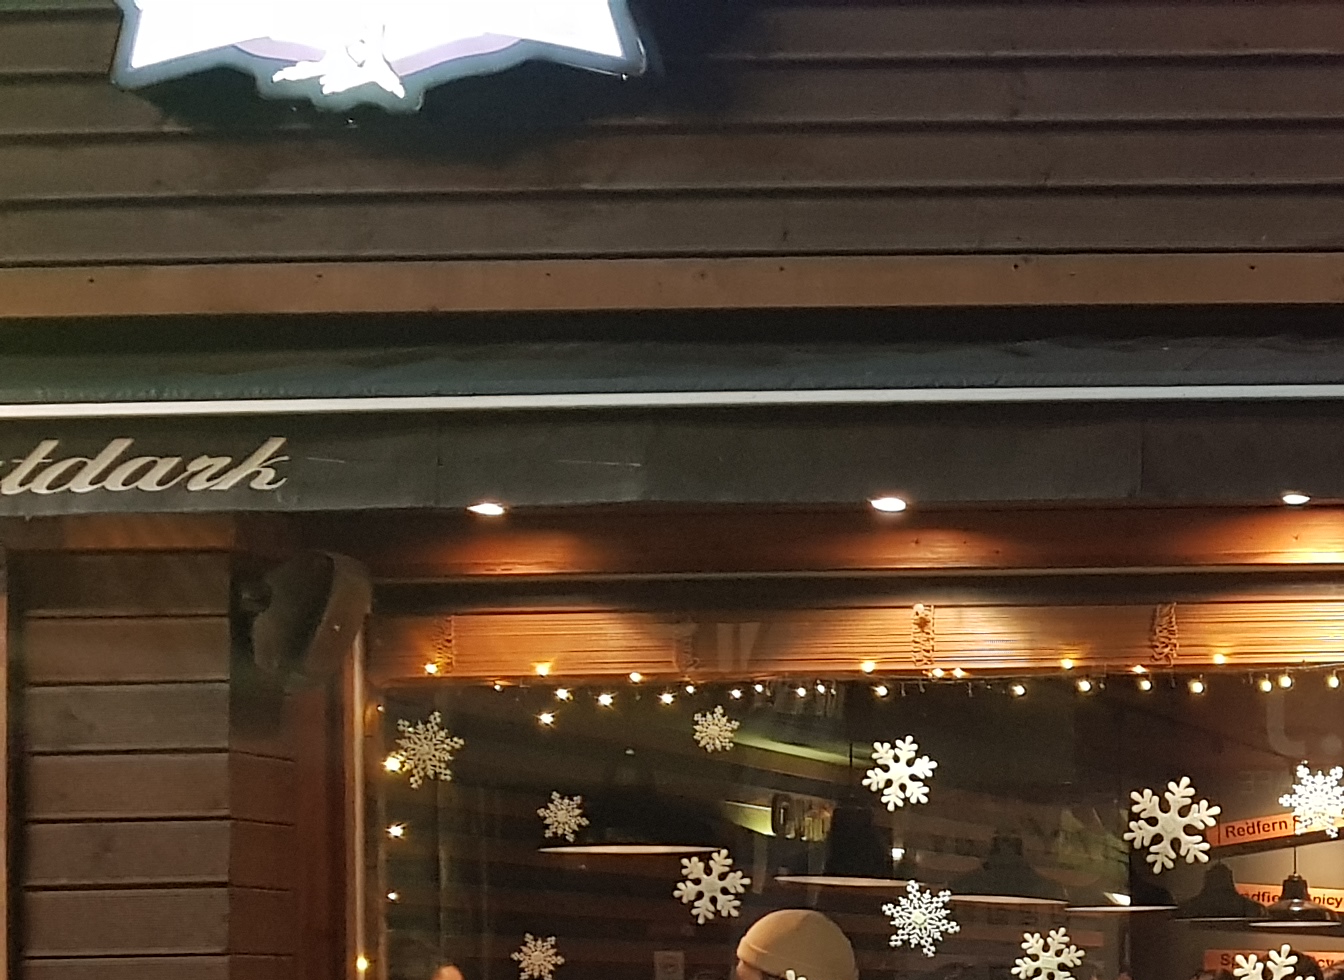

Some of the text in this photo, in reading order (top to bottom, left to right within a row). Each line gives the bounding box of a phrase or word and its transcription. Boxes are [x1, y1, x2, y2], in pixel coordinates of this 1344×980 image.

[0, 436, 291, 495] tdark
[1225, 820, 1288, 839] Redfern
[1313, 893, 1343, 909] picy
